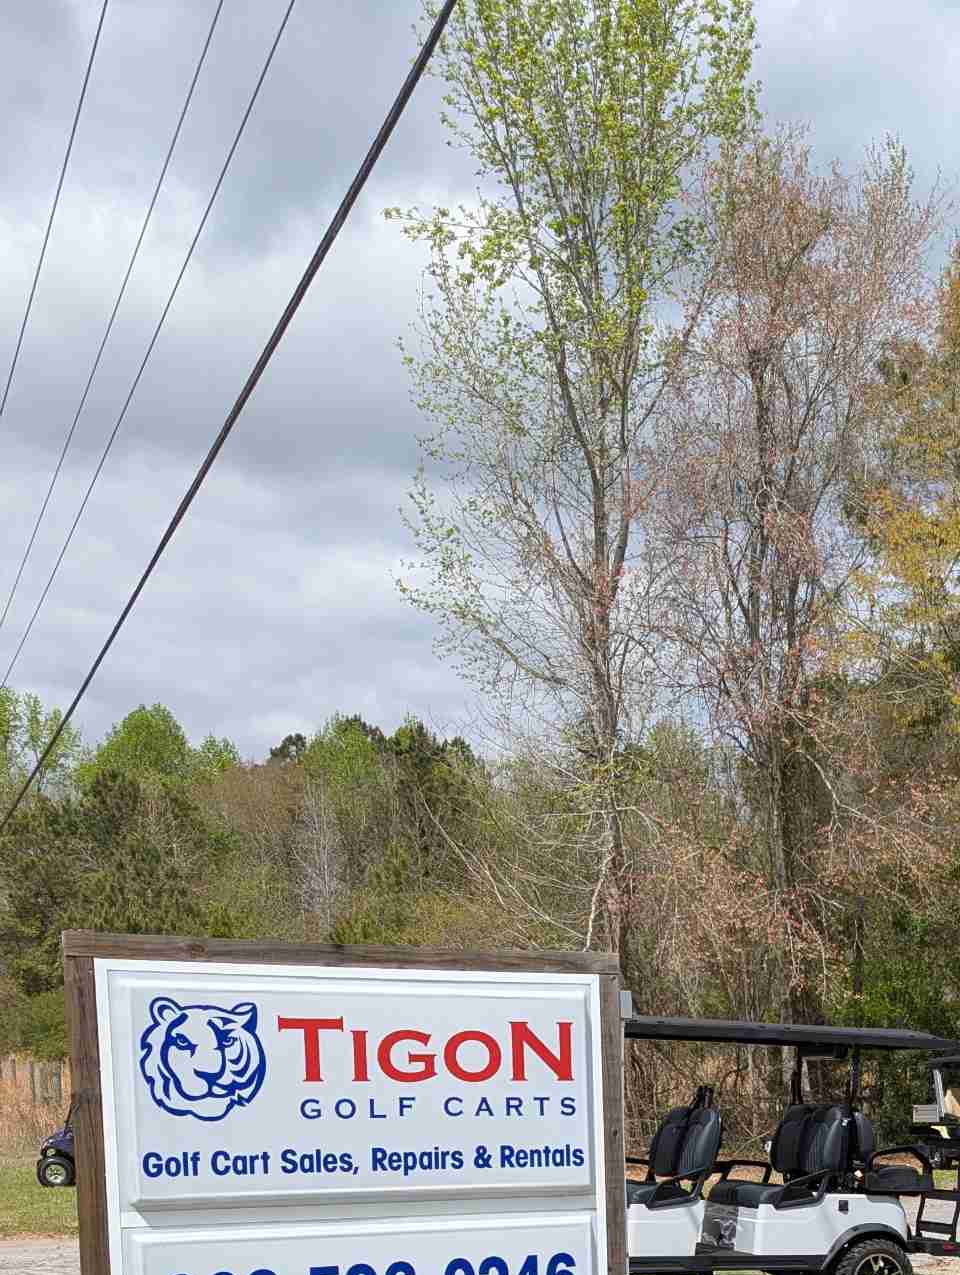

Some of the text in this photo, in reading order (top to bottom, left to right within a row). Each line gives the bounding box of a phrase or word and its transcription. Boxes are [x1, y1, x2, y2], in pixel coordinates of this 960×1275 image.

[277, 1016, 573, 1084] TIGON
[300, 1096, 577, 1120] GOLF CARTS
[142, 1143, 585, 1178] Golf Cart Sales, Repairs & Rentals
